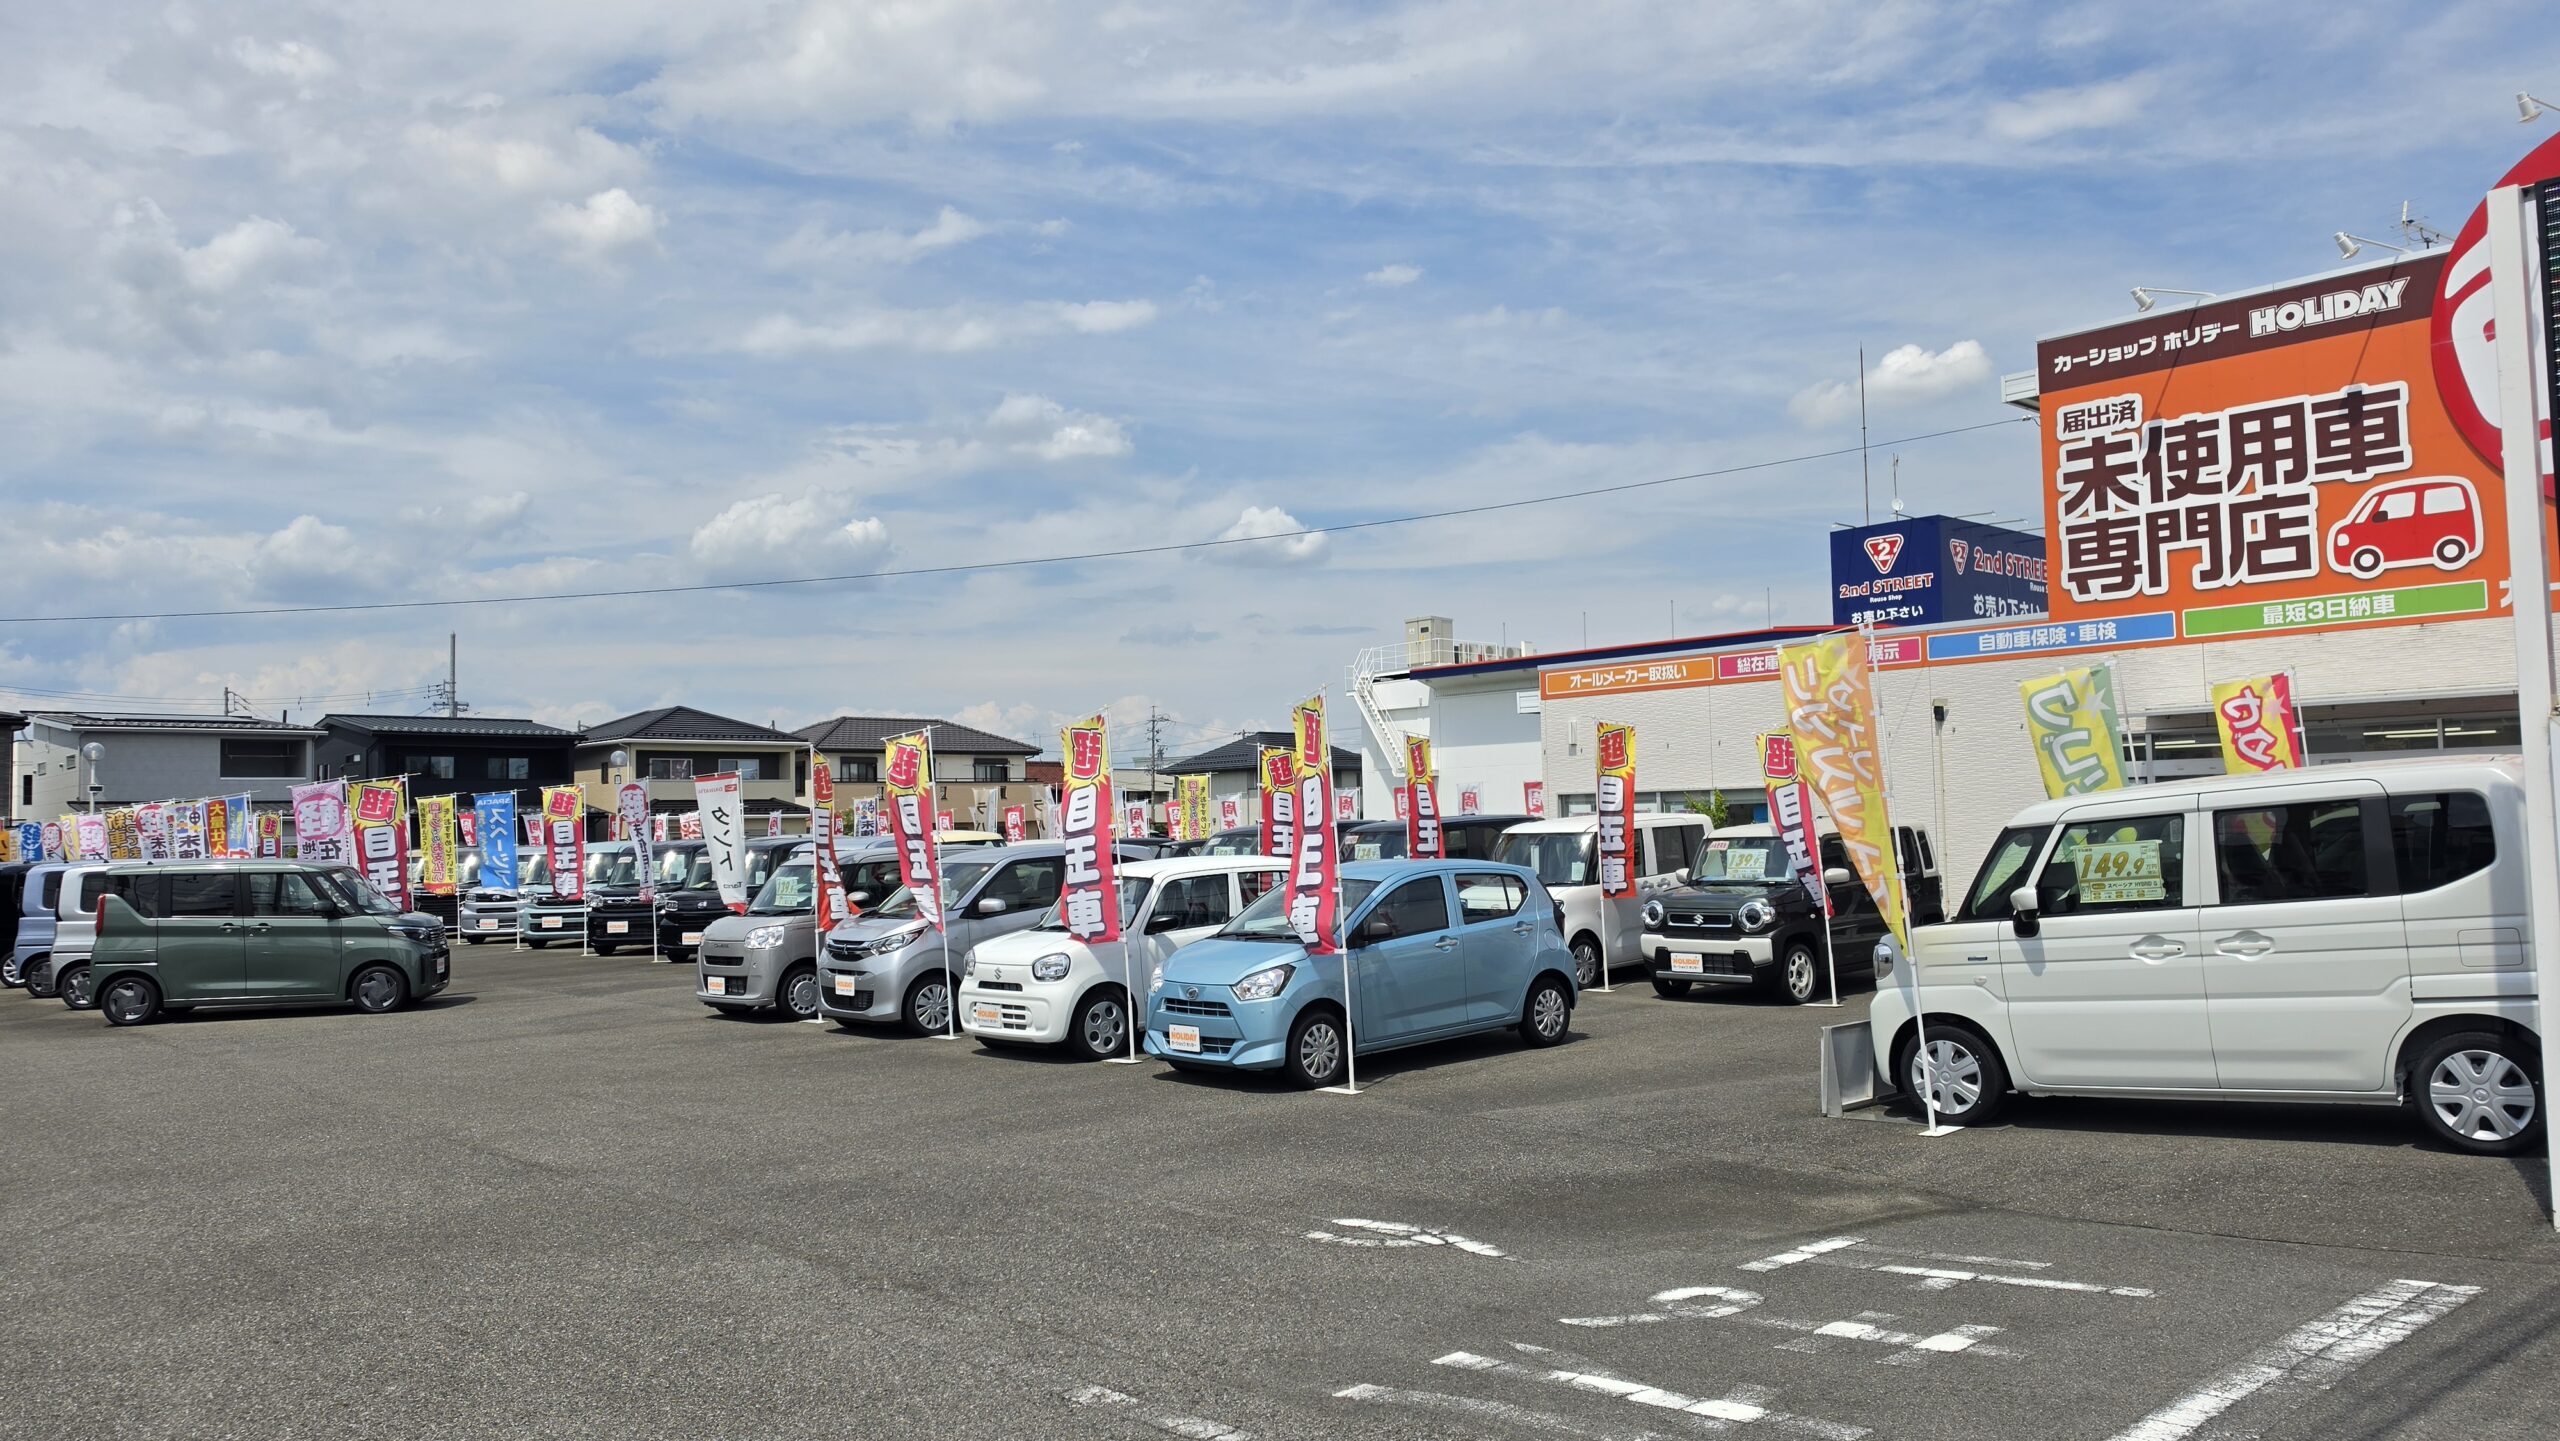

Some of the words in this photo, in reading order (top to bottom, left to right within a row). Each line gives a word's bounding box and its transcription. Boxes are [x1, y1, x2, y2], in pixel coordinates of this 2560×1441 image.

[2054, 336, 2157, 374] カーショップ
[2163, 322, 2240, 351] ホリデー
[2249, 276, 2411, 338] HOLIDAY
[2062, 399, 2137, 435] 届出済
[2061, 386, 2406, 517] 未使用車
[2064, 492, 2314, 598] 専門店
[1973, 546, 2003, 575] 2nd
[2005, 552, 2047, 583] STREE
[1839, 579, 1870, 598] 2nd
[1872, 572, 1934, 594] STREET
[1851, 604, 1924, 624] お売り下さい
[1973, 593, 2040, 617] お売り下さい
[2262, 595, 2396, 627] 最短3日納車
[1978, 621, 2117, 652] 自動車保険・車検
[1569, 664, 1687, 690] オールメーカー取扱い
[1266, 753, 1294, 857] 超目玉
[1599, 728, 1628, 895] 超目玉車
[2081, 851, 2145, 879] 149.9
[1673, 957, 1700, 966] HOLIDAY
[1171, 1031, 1198, 1042] HOLIDAY
